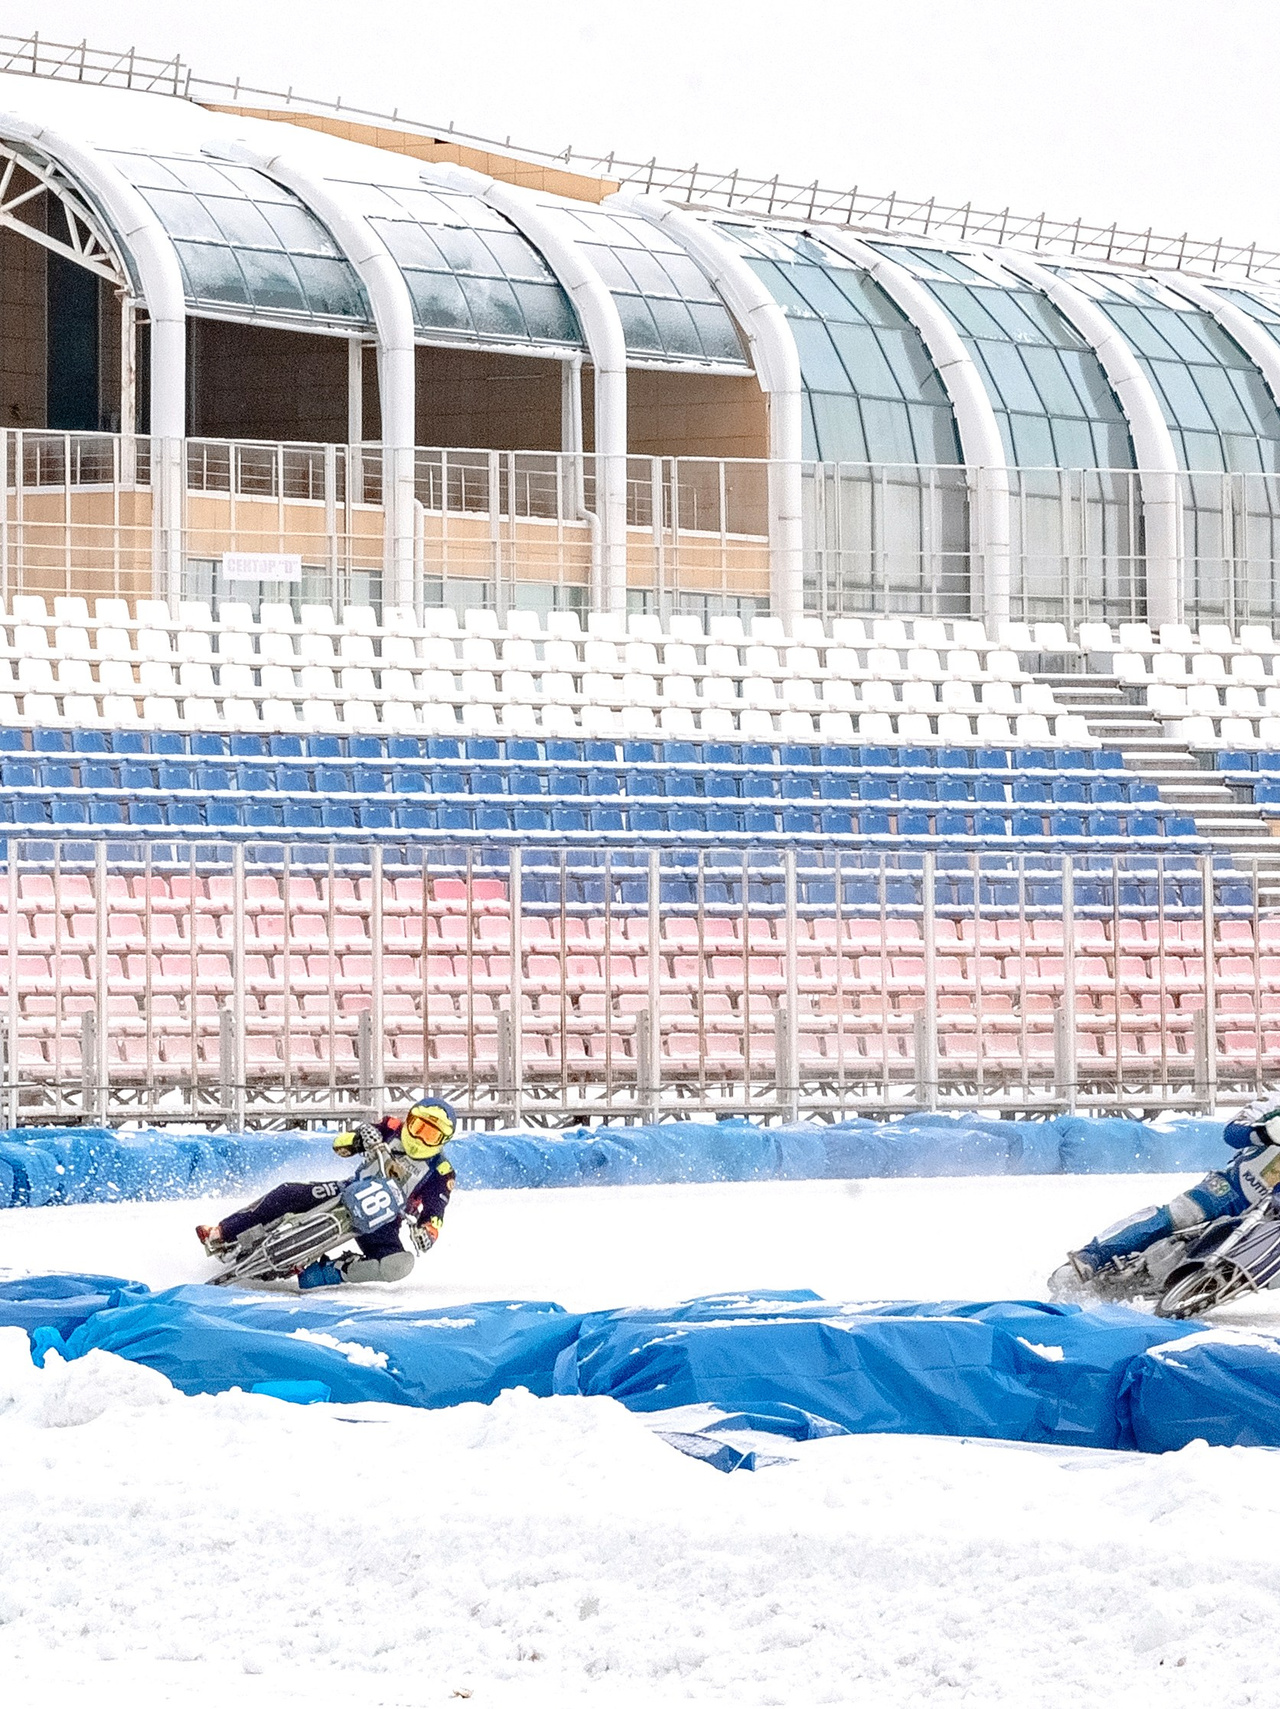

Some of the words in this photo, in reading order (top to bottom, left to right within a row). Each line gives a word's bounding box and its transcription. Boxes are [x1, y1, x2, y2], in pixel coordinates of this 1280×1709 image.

[227, 558, 276, 573] СЕКТОР
[311, 1182, 339, 1199] elf
[354, 1181, 395, 1228] 181
